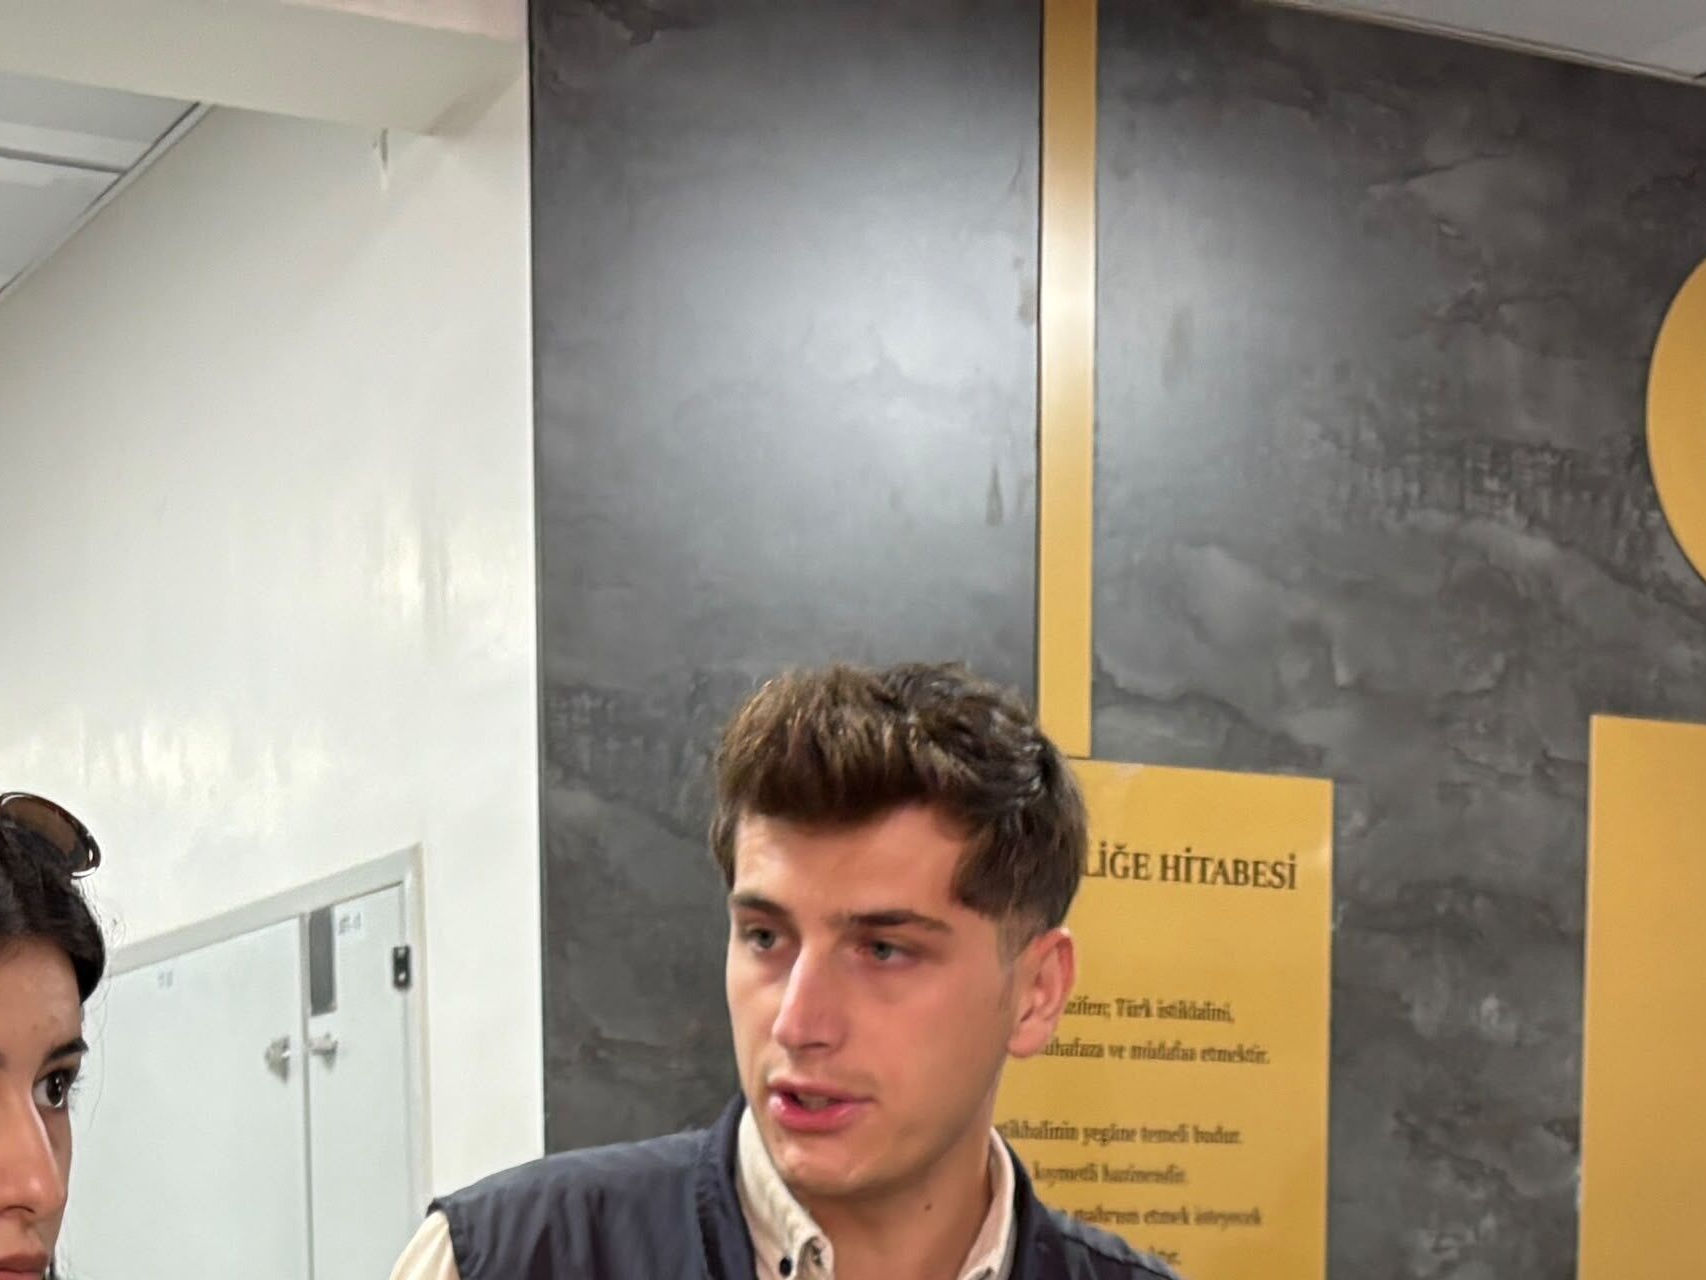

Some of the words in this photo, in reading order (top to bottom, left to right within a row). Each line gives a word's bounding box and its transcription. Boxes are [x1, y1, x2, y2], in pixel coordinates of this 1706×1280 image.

[1083, 840, 1152, 881] LİĞE
[1159, 847, 1297, 890] HİTABESİ
[1044, 1037, 1104, 1058] uhafaza
